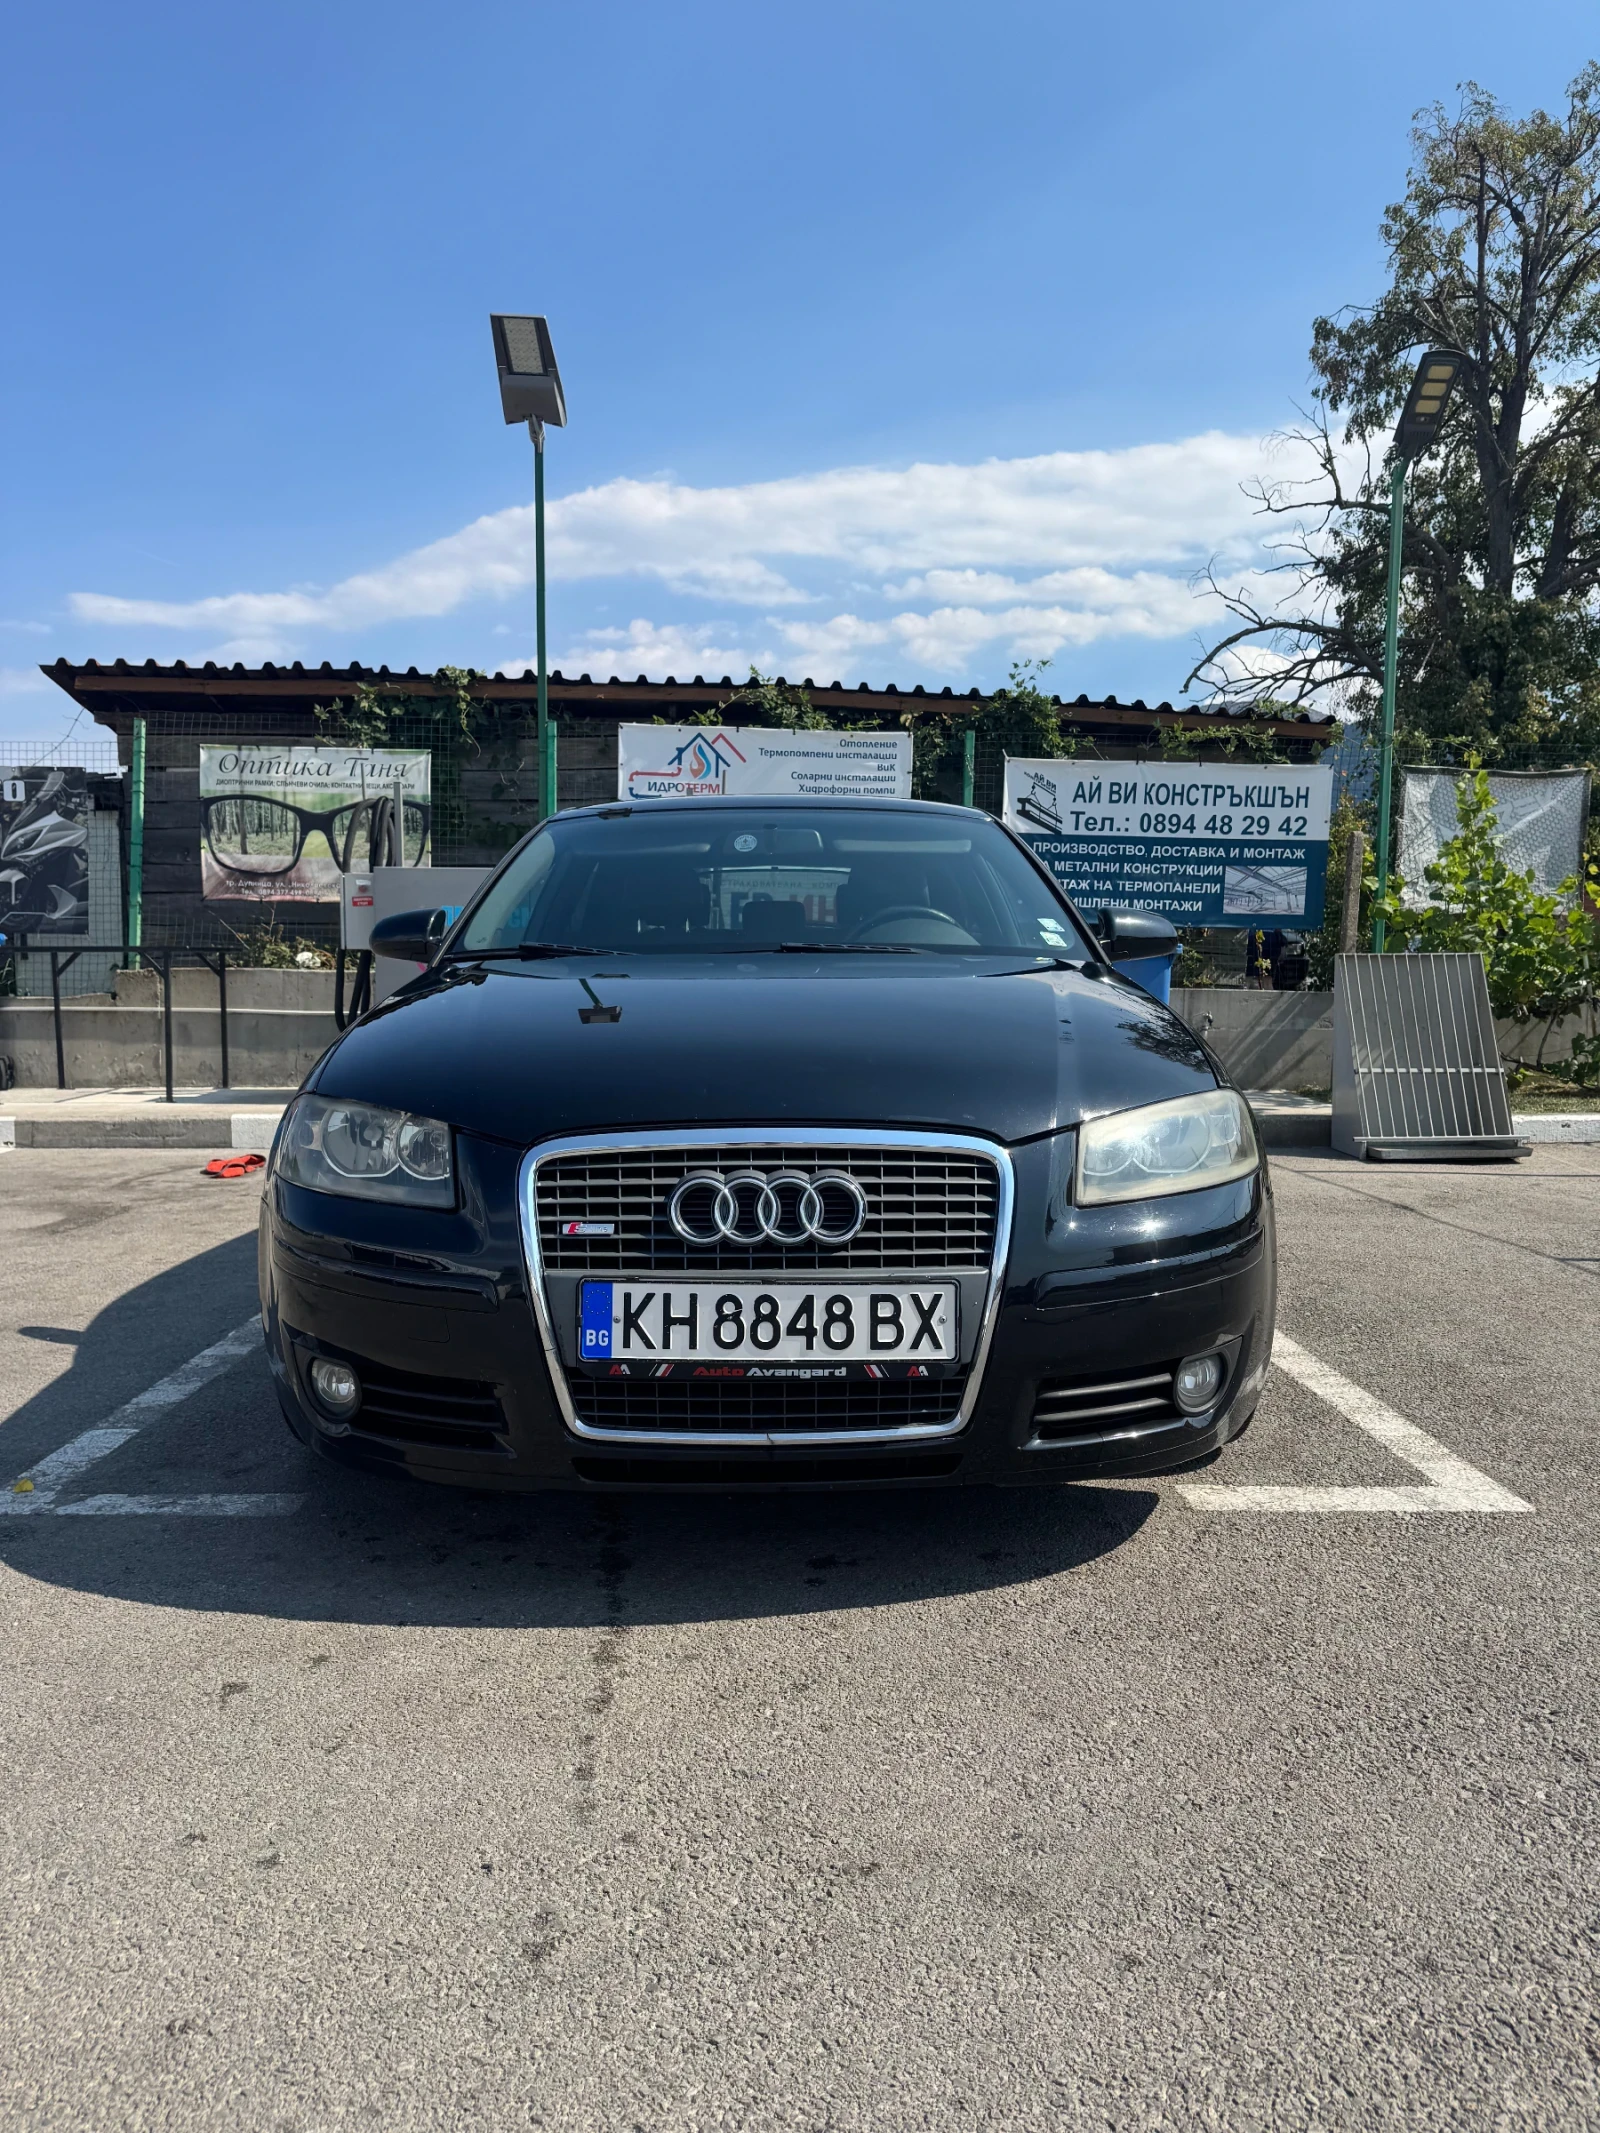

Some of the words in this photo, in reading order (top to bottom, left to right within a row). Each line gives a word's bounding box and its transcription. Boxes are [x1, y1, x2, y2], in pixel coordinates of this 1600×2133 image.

[839, 739, 898, 748] Отопление
[758, 747, 833, 760] Термопомпени
[836, 751, 898, 760] инсталации
[219, 753, 334, 777] Оптика
[344, 757, 407, 778] Таня
[877, 763, 896, 772] ВиК
[791, 771, 832, 783] Соларни
[834, 773, 897, 783] инсталации
[647, 781, 720, 794] ИДРОТЕРМ
[798, 784, 861, 796] Хидрофорни
[863, 786, 896, 795] помпи
[1072, 776, 1102, 804] АЙ
[1108, 782, 1138, 804] ВИ
[1144, 783, 1310, 808] КОНСТРЪКШЪН
[1070, 811, 1129, 832] Тел.:
[1140, 813, 1196, 834] 0894
[1204, 814, 1233, 835] 48
[1241, 815, 1271, 836] 29
[1278, 815, 1308, 836] 42
[1033, 842, 1148, 858] ПРОИЗВОДСТВО,
[1151, 845, 1226, 858] ДОСТАВКА
[1230, 847, 1239, 858] И
[1243, 848, 1306, 860] МОНТАЖ
[1054, 861, 1120, 873] МЕТАЛНИ
[1123, 863, 1223, 877] КОНСТРУКЦИИ
[1059, 879, 1090, 890] ТАЖ
[1094, 880, 1113, 891] НА
[1117, 881, 1221, 894] ТЕРМОПАНЕЛИ
[1072, 897, 1128, 908] ИШЛЕНИ
[1132, 899, 1203, 912] МОНТАЖИ
[712, 1293, 855, 1350] 8848
[585, 1329, 609, 1346] BG
[693, 1366, 744, 1377] Auto
[746, 1366, 847, 1379] Avangard
